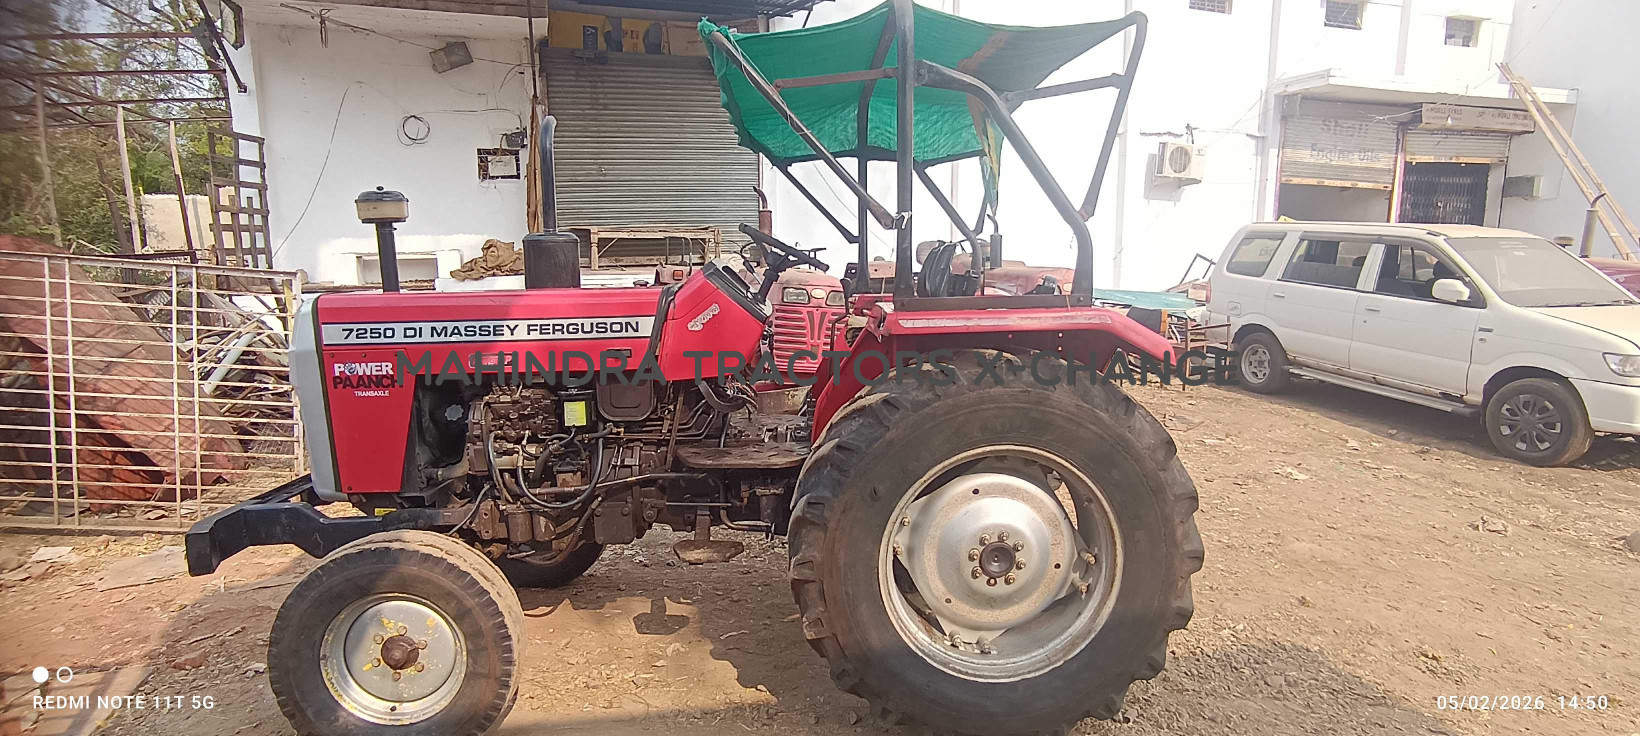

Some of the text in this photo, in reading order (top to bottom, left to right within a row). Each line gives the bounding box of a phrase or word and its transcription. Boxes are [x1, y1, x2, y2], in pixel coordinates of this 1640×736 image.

[1311, 143, 1381, 163] Engine Oils
[341, 321, 640, 341] 7250 DI MASSEY FERGUSON
[333, 361, 394, 376] POWER
